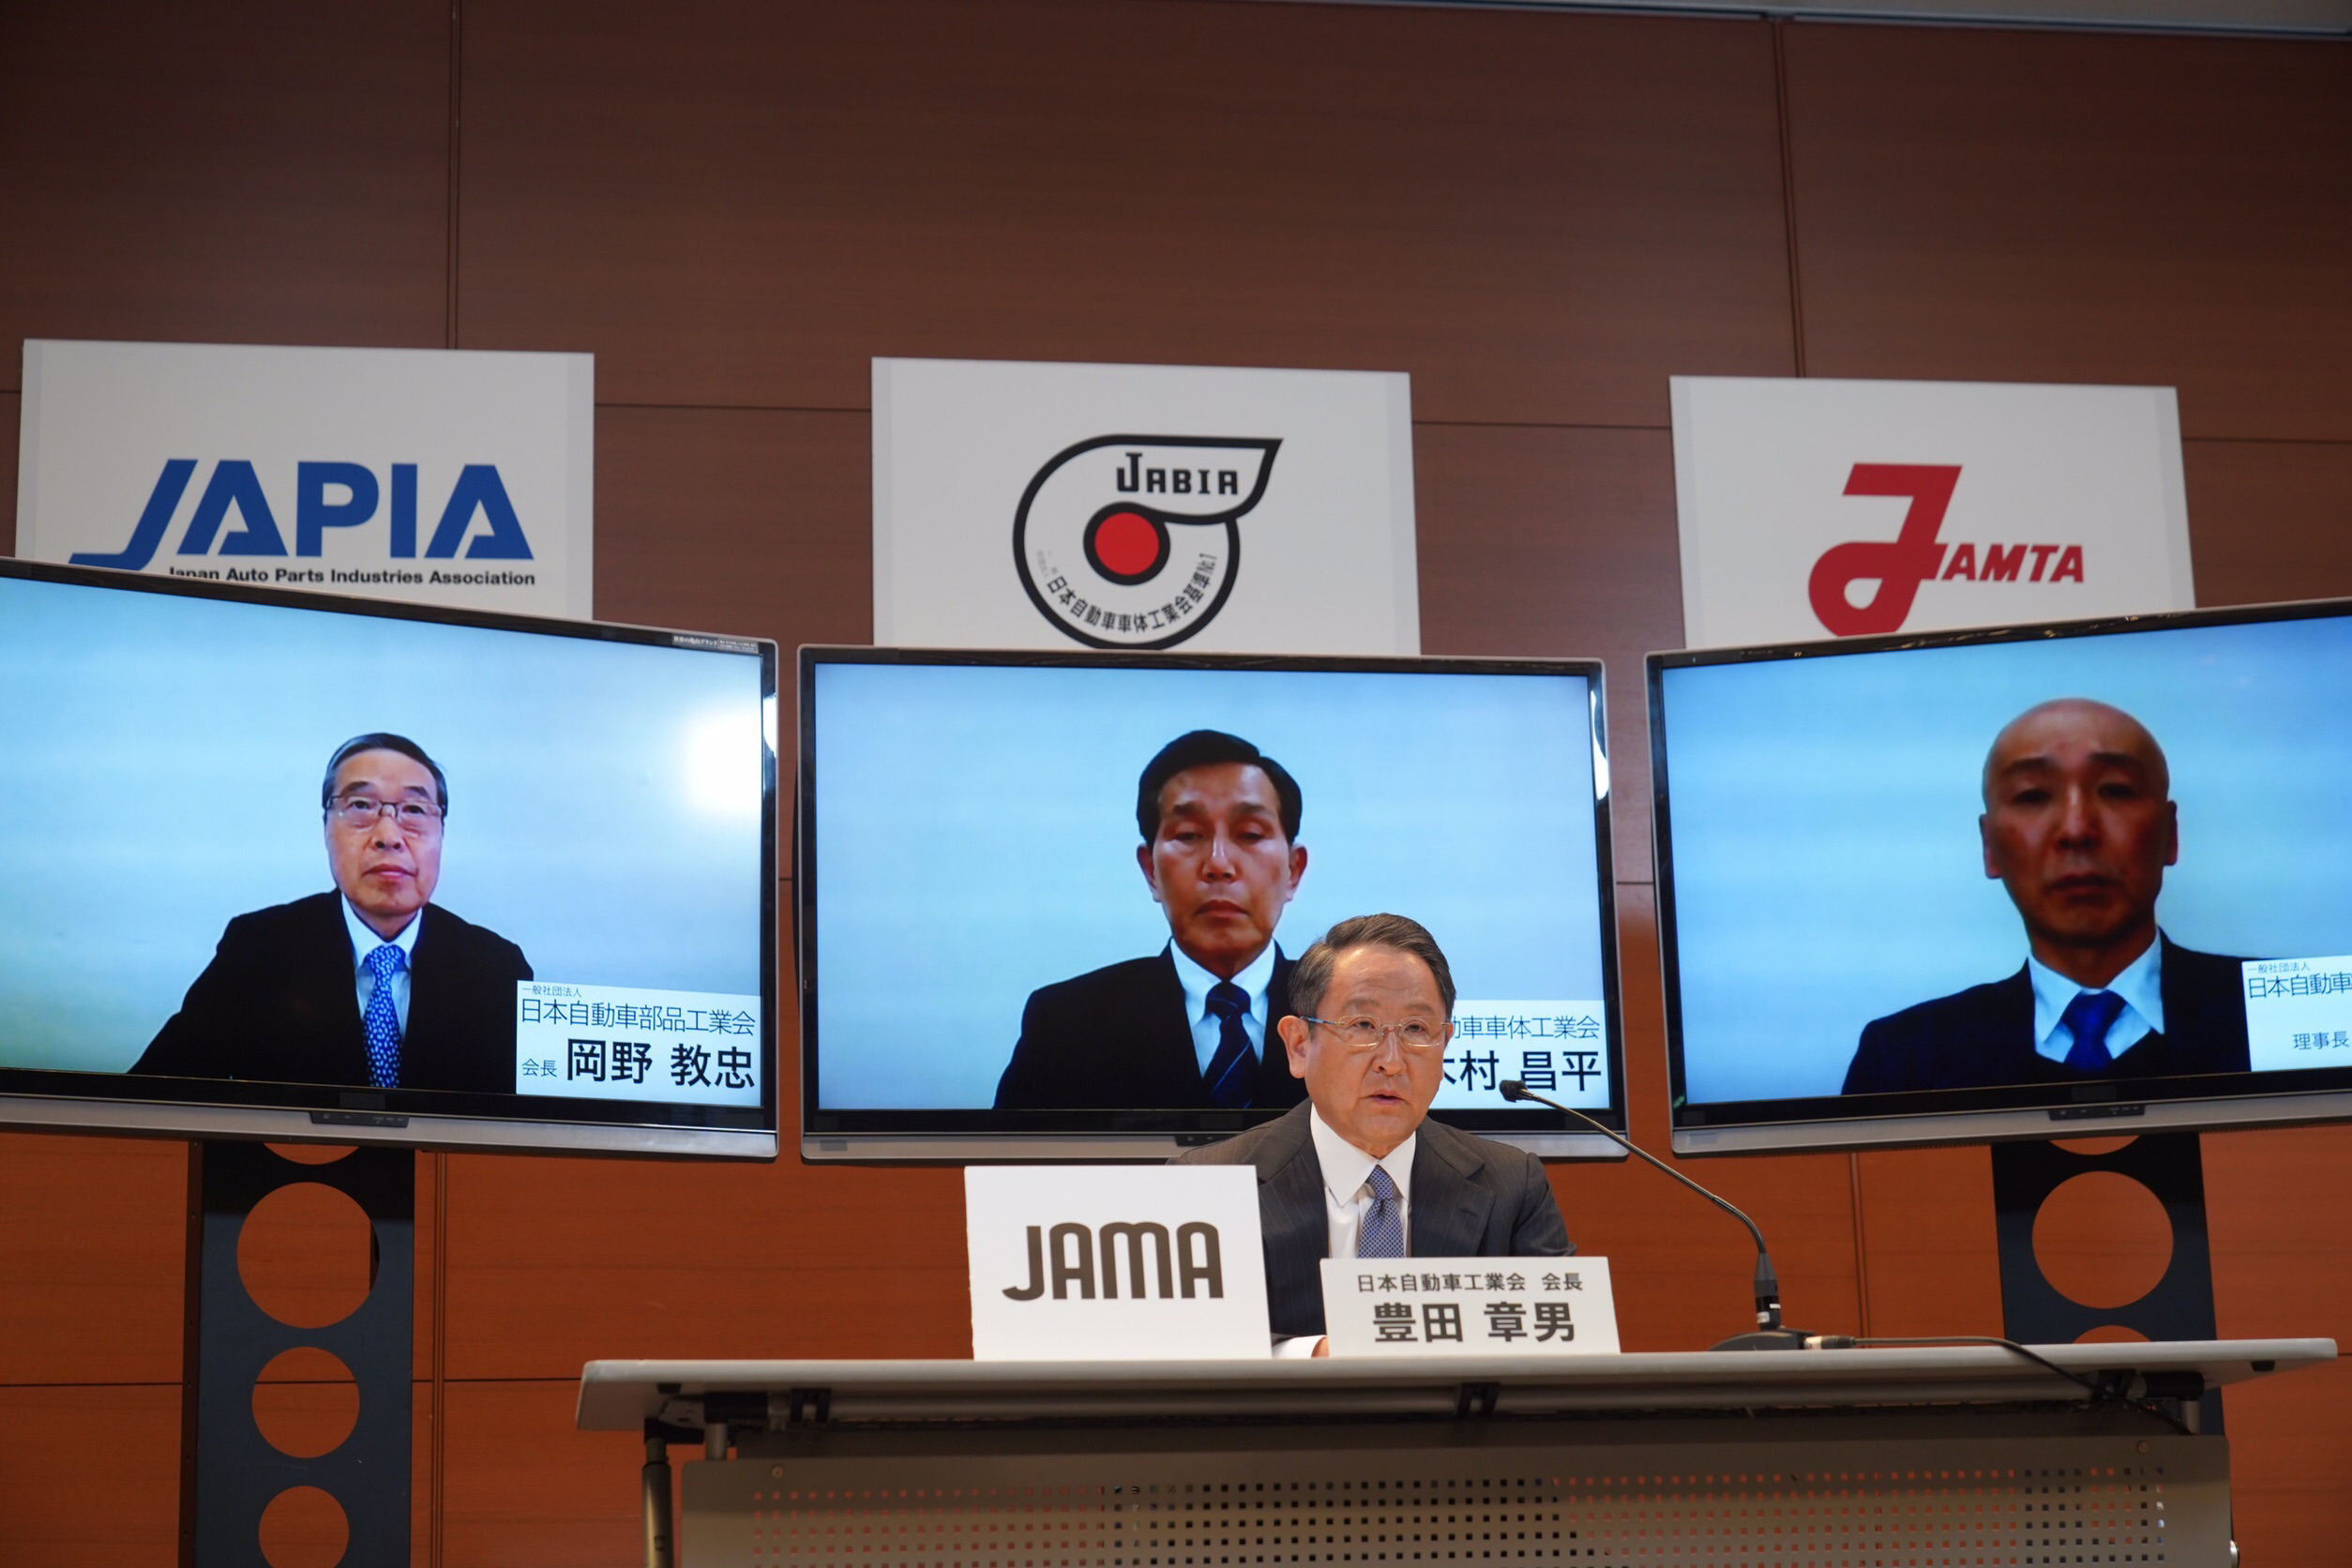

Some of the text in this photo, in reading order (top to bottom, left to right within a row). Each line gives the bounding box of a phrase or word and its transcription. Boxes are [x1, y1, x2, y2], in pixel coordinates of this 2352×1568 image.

[1116, 452, 1238, 495] JABIA
[68, 459, 535, 571] JAPIA
[1808, 462, 2084, 637] JAMTA
[226, 567, 269, 581] Auto
[275, 568, 324, 582] Parts
[331, 569, 423, 584] Industries
[429, 570, 535, 585] Association
[521, 985, 582, 998] 一般社団法人
[521, 998, 756, 1035] 日本自動車部品工業会
[1453, 1015, 1600, 1039] 車車体工業会
[2292, 1031, 2350, 1049] 理事長
[521, 1038, 755, 1089] 会長 岡野 教忠
[1520, 1050, 1602, 1092] 昌平
[1002, 1221, 1224, 1302] JAMA
[1358, 1273, 1584, 1292] 日本自動車工業会 会長
[1373, 1301, 1576, 1343] 豊田 章男
